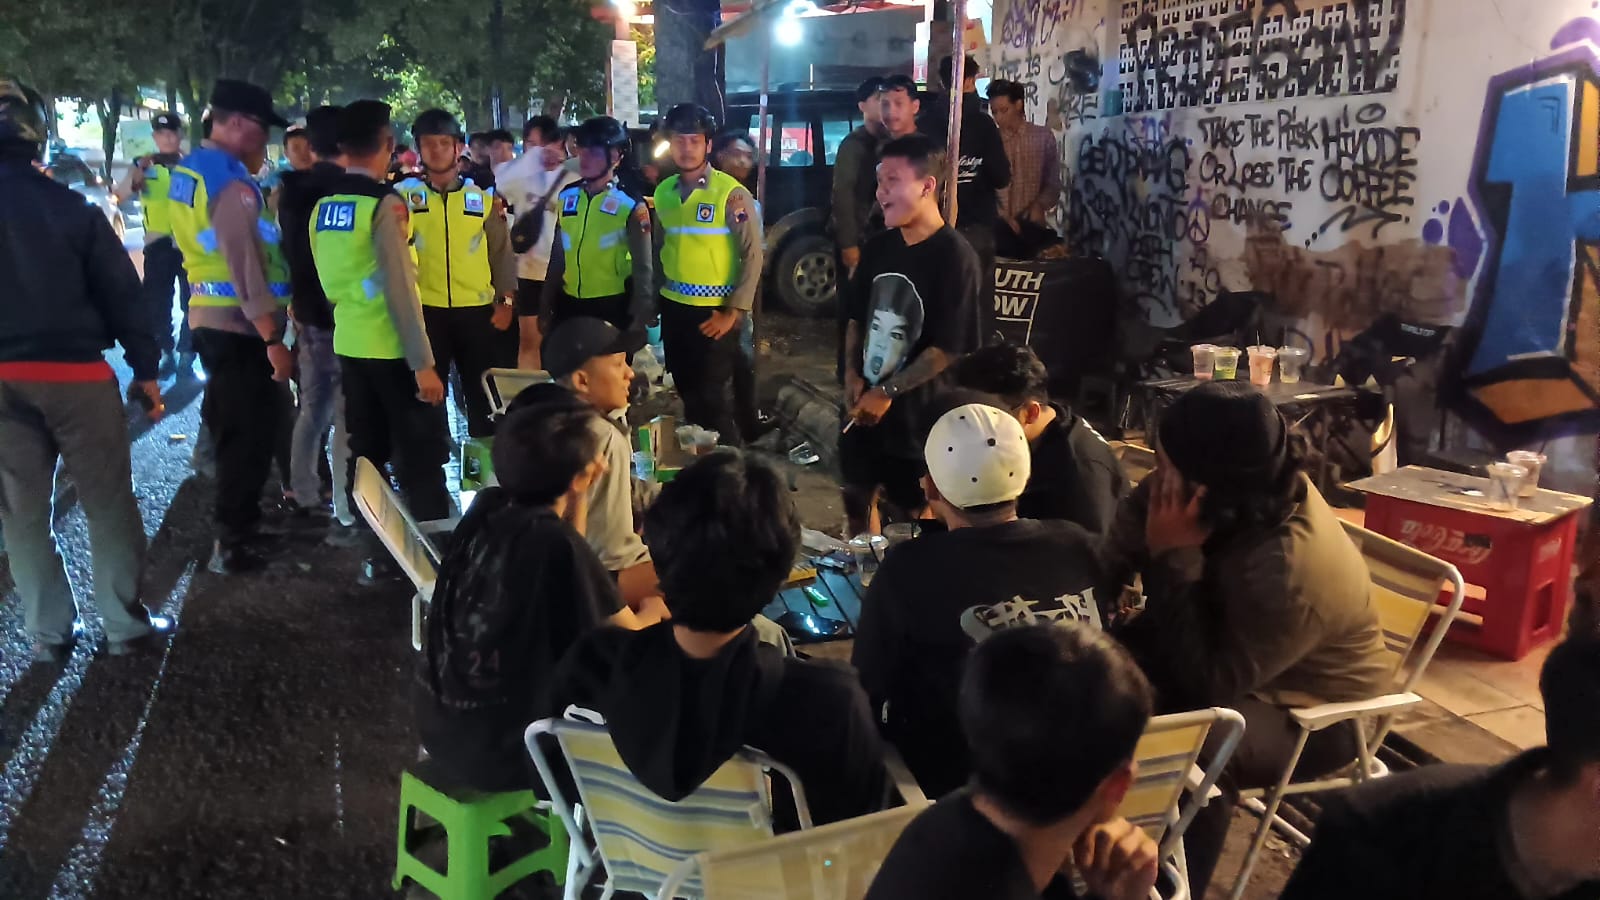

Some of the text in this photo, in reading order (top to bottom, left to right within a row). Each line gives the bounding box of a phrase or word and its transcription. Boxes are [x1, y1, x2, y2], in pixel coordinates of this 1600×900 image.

[1198, 116, 1245, 149] TAKE
[1245, 114, 1274, 149] THE
[1278, 106, 1319, 151] RISK
[1278, 157, 1314, 193] THE
